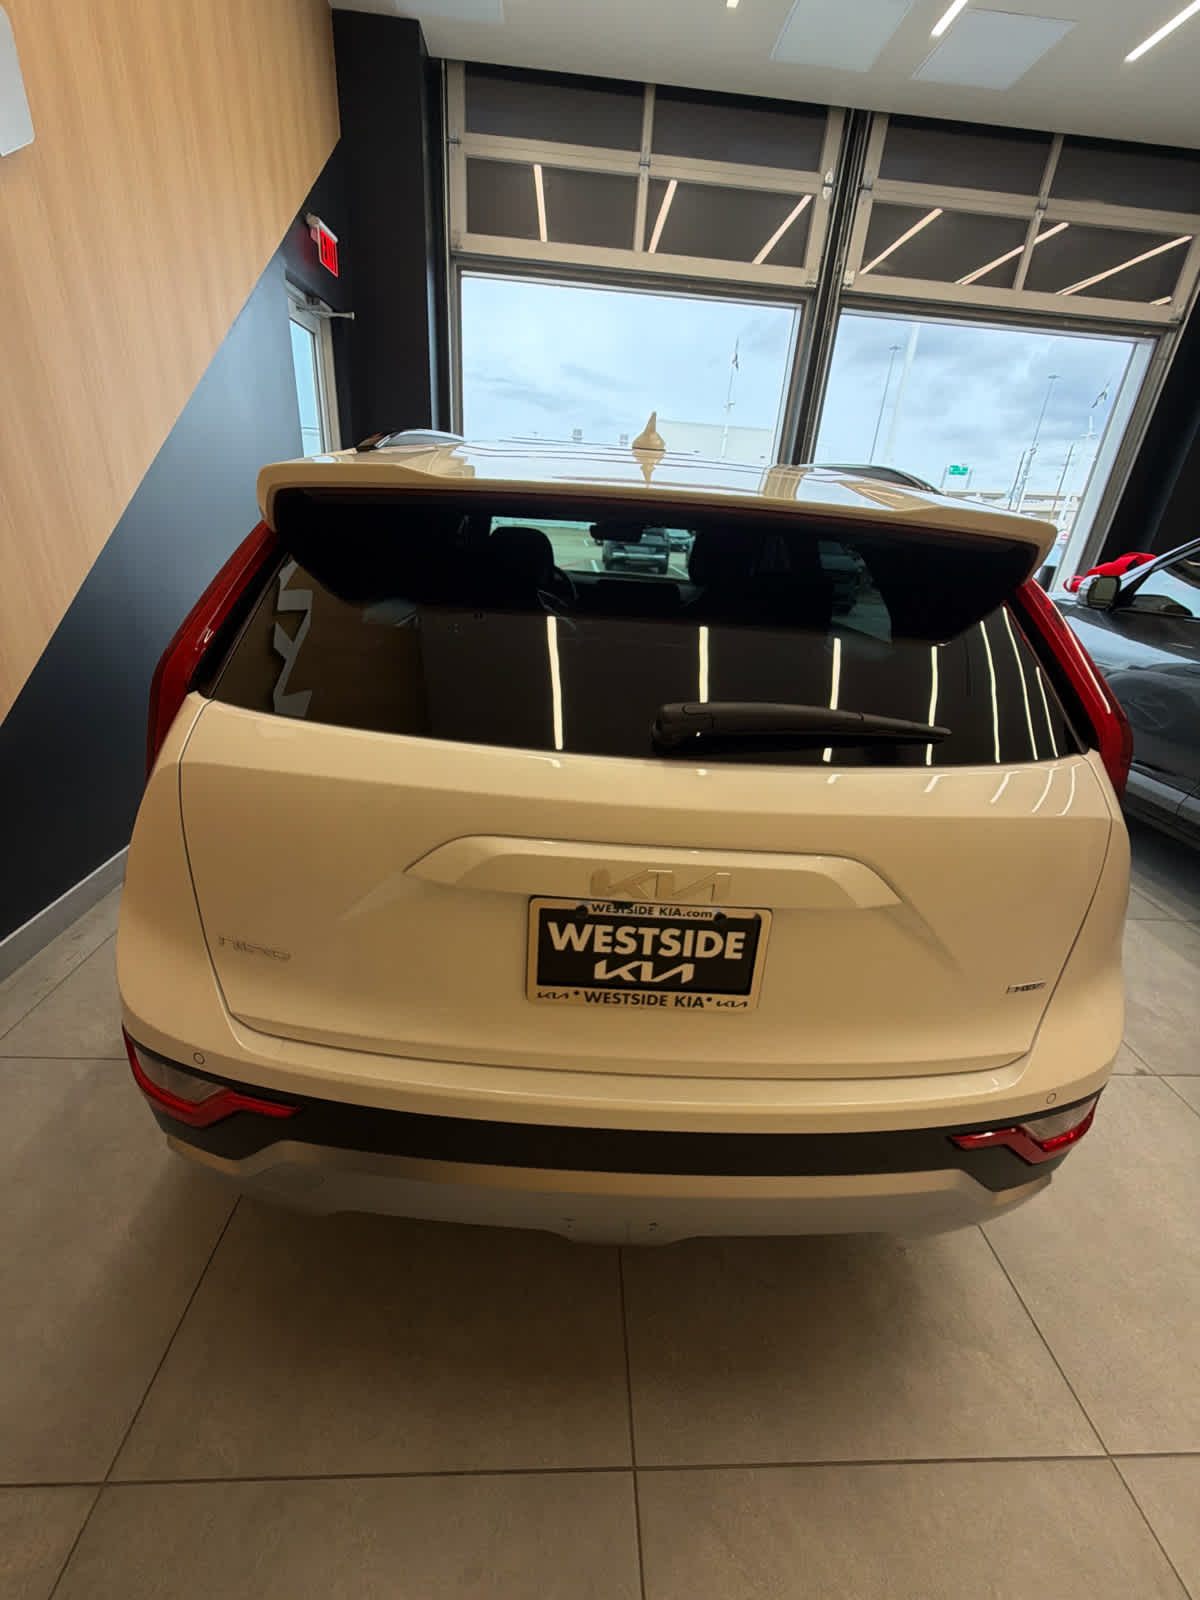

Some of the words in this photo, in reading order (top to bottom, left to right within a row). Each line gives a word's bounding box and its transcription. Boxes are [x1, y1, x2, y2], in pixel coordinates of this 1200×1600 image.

[589, 868, 731, 901] KIA
[659, 907, 712, 918] KIA.com
[547, 921, 746, 960] WESTSIDE
[594, 959, 695, 984] KIA
[583, 990, 667, 1007] WESTSIDE
[673, 995, 705, 1009] KIA
